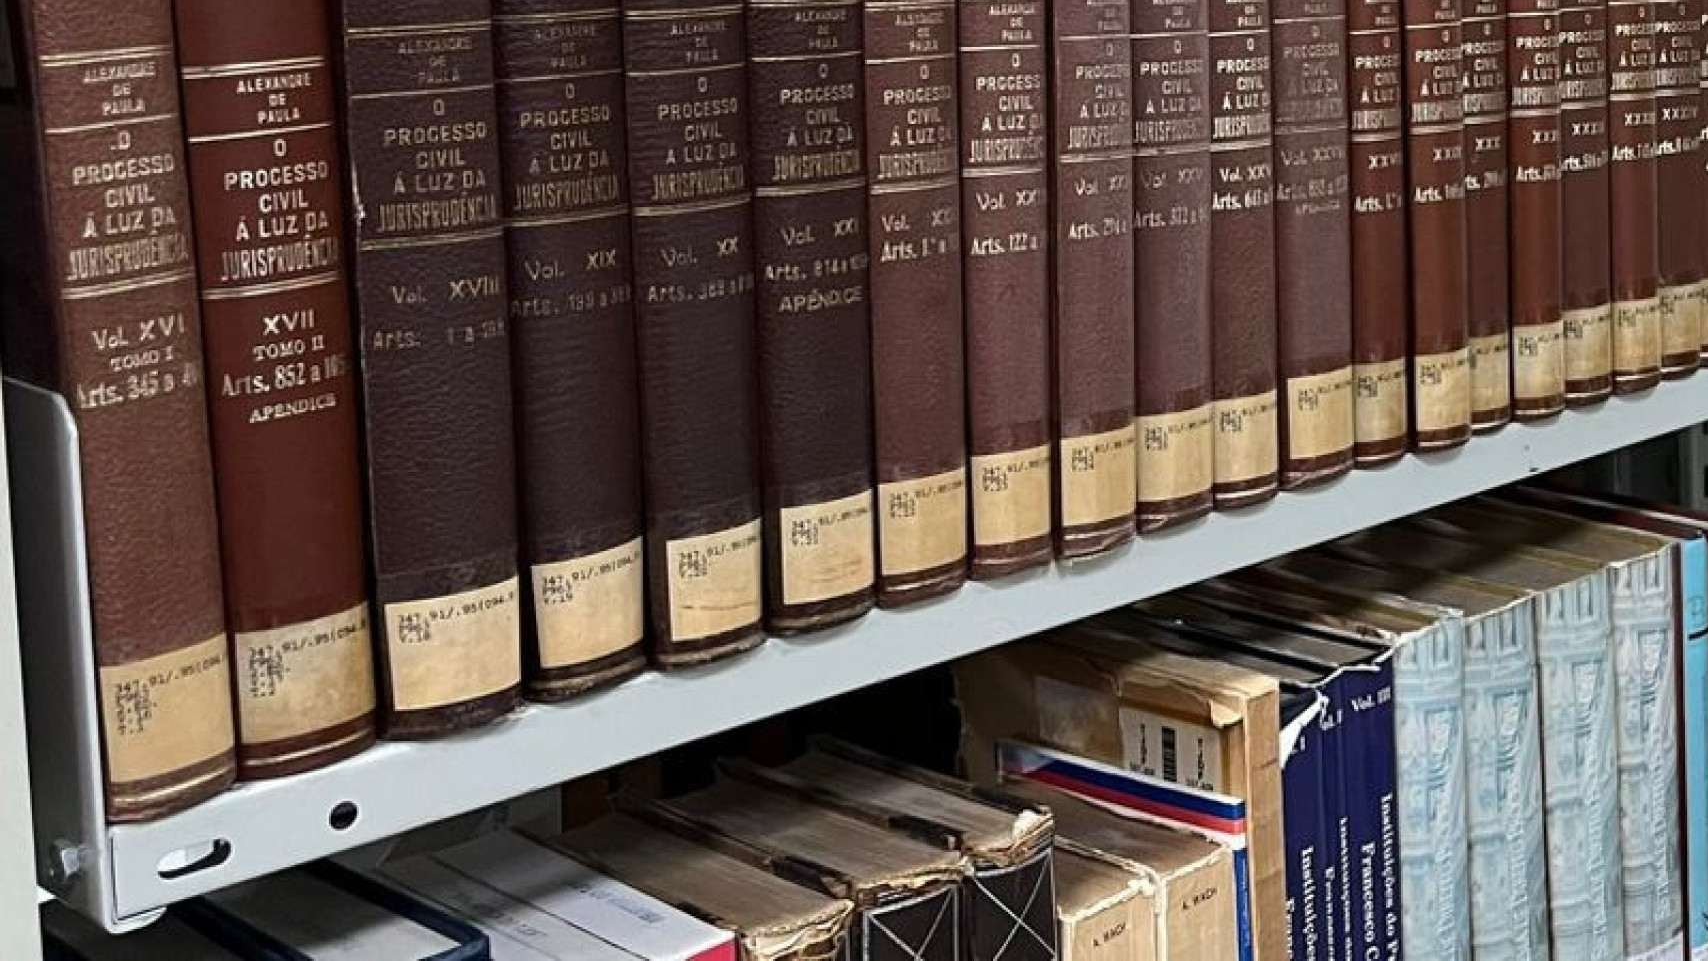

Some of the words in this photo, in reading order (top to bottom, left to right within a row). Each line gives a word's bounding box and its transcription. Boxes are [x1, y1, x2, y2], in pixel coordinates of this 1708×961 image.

[236, 72, 313, 94] ALEXANDRE
[780, 83, 855, 106] PROCESSO
[102, 99, 146, 116] PAULA
[268, 93, 287, 108] DE
[433, 98, 445, 116] O
[657, 96, 738, 121] PROCESSO
[999, 95, 1034, 111] CIVIL
[257, 107, 301, 125] PAULA
[519, 104, 611, 128] PROCESSO
[805, 105, 841, 126] CIVIL
[907, 107, 942, 126] CIVIL
[383, 121, 488, 147] PROCESSO
[550, 129, 593, 151] CIVIL
[684, 120, 723, 143] CIVIL
[273, 138, 287, 157] O
[415, 147, 466, 170] CIVIL
[72, 153, 176, 186] PROCESSO
[549, 153, 583, 173] LUZ
[588, 150, 610, 169] DA
[224, 161, 329, 191] PROCESSO
[415, 172, 454, 193] LUZ
[462, 169, 486, 189] DA
[104, 183, 156, 209] CIVIL
[258, 188, 309, 214] CIVIL
[106, 209, 144, 236] LUZ
[150, 206, 176, 228] DA
[258, 215, 299, 239] LUZ
[304, 210, 330, 232] DA
[585, 248, 617, 271] XIX
[139, 311, 185, 342] XVI
[262, 308, 315, 337] XVII
[111, 349, 160, 373] TOMO
[253, 339, 305, 362] TOMO
[222, 374, 271, 397] Arts.
[273, 363, 305, 390] 852
